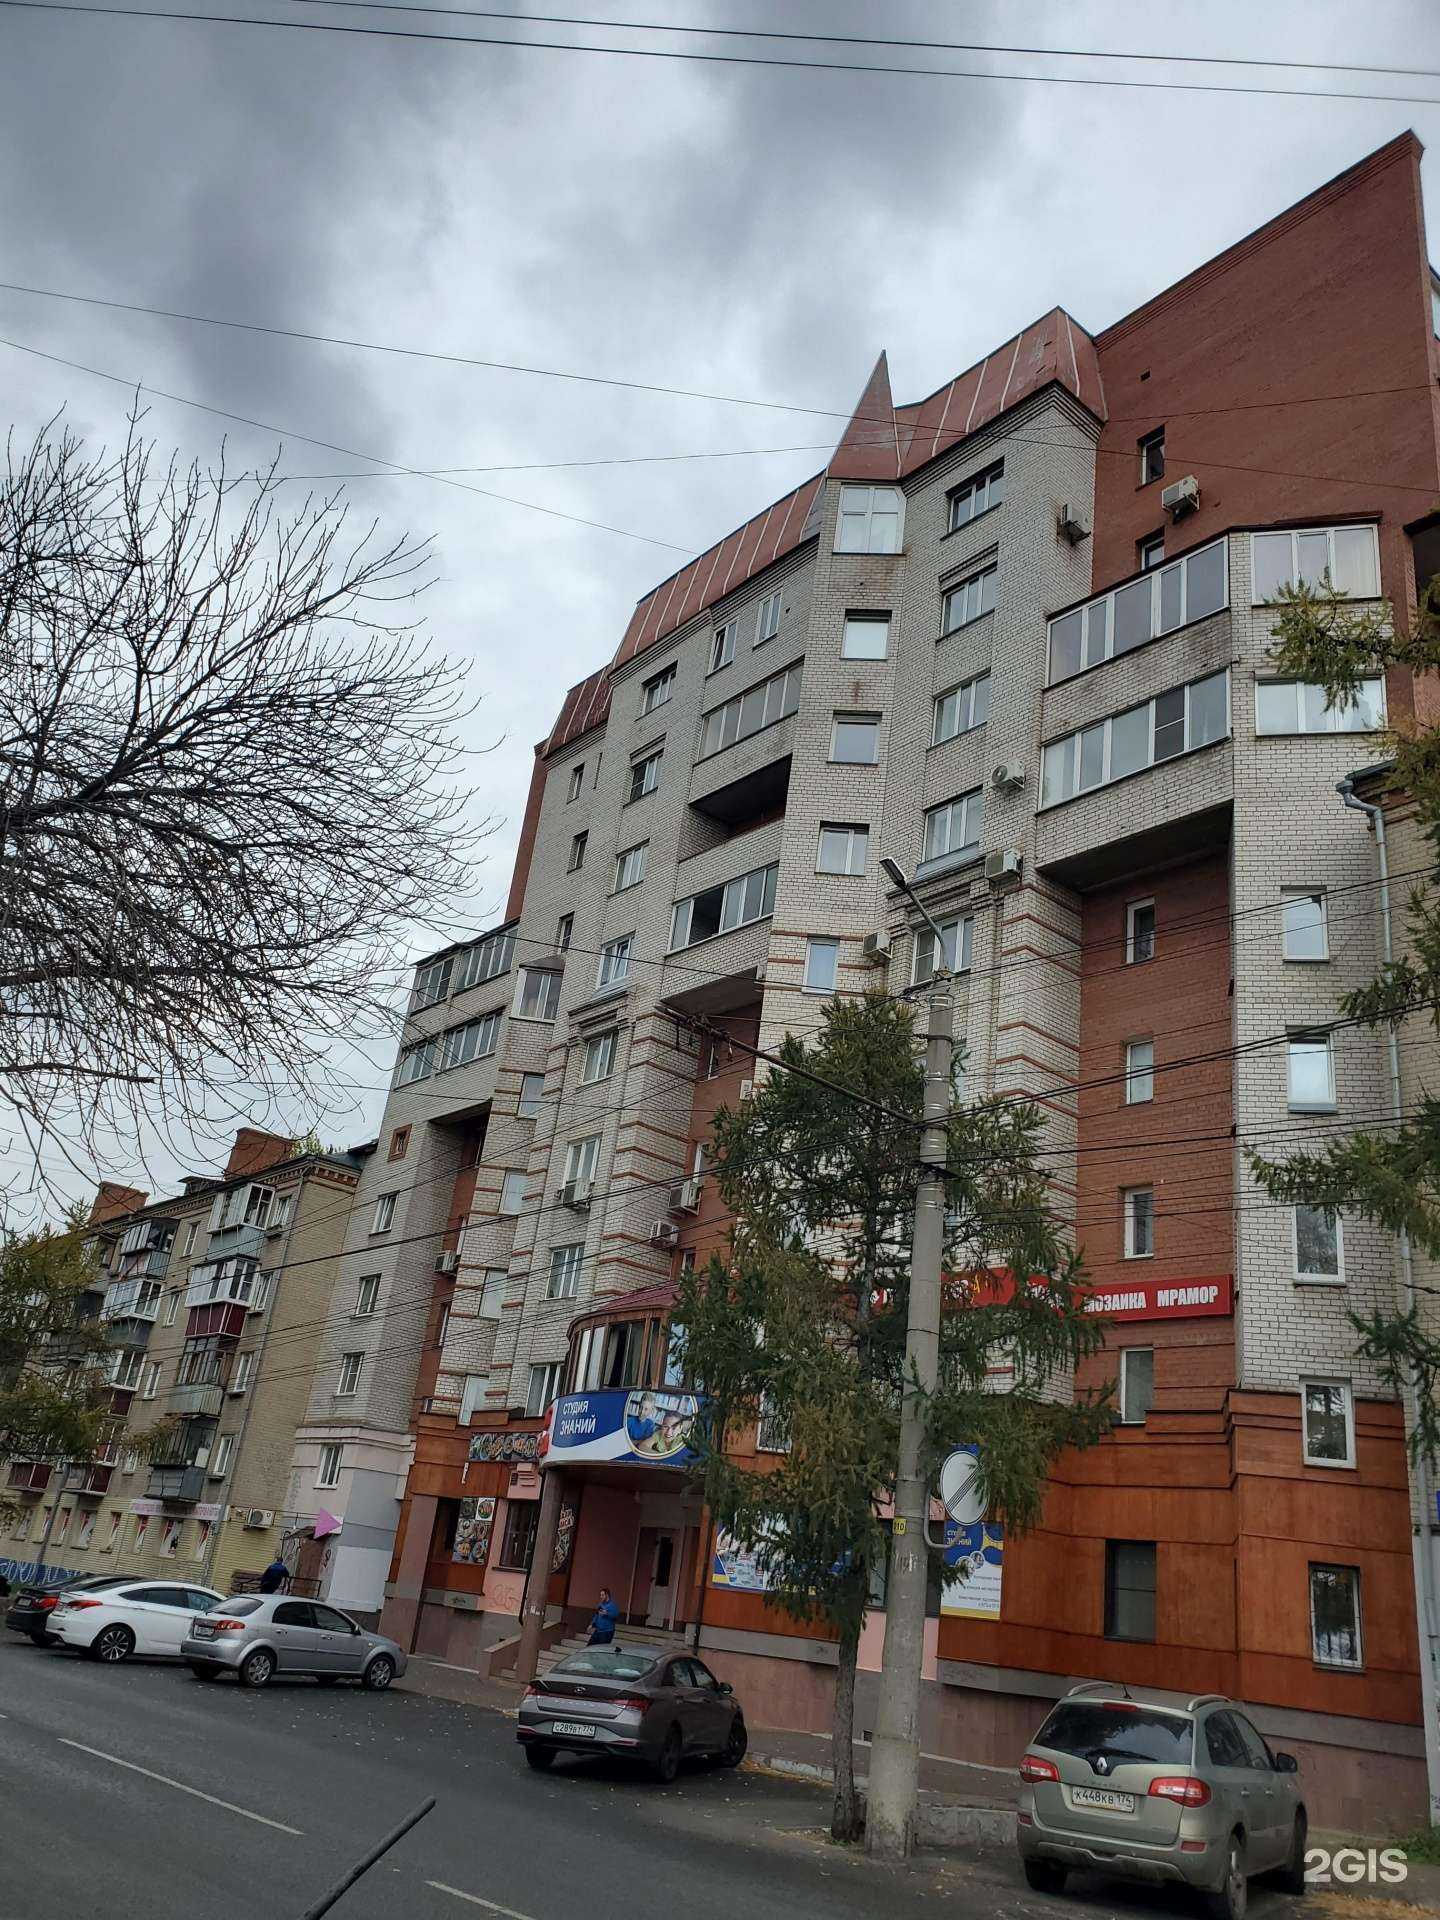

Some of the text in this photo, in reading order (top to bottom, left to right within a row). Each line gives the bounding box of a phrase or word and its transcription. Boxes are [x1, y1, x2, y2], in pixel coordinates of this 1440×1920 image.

[1157, 1285, 1219, 1307] МРАМОР
[562, 1400, 589, 1416] СТУДИЯ
[559, 1414, 597, 1436] ЗНАНИЙ
[1117, 1793, 1131, 1804] 174
